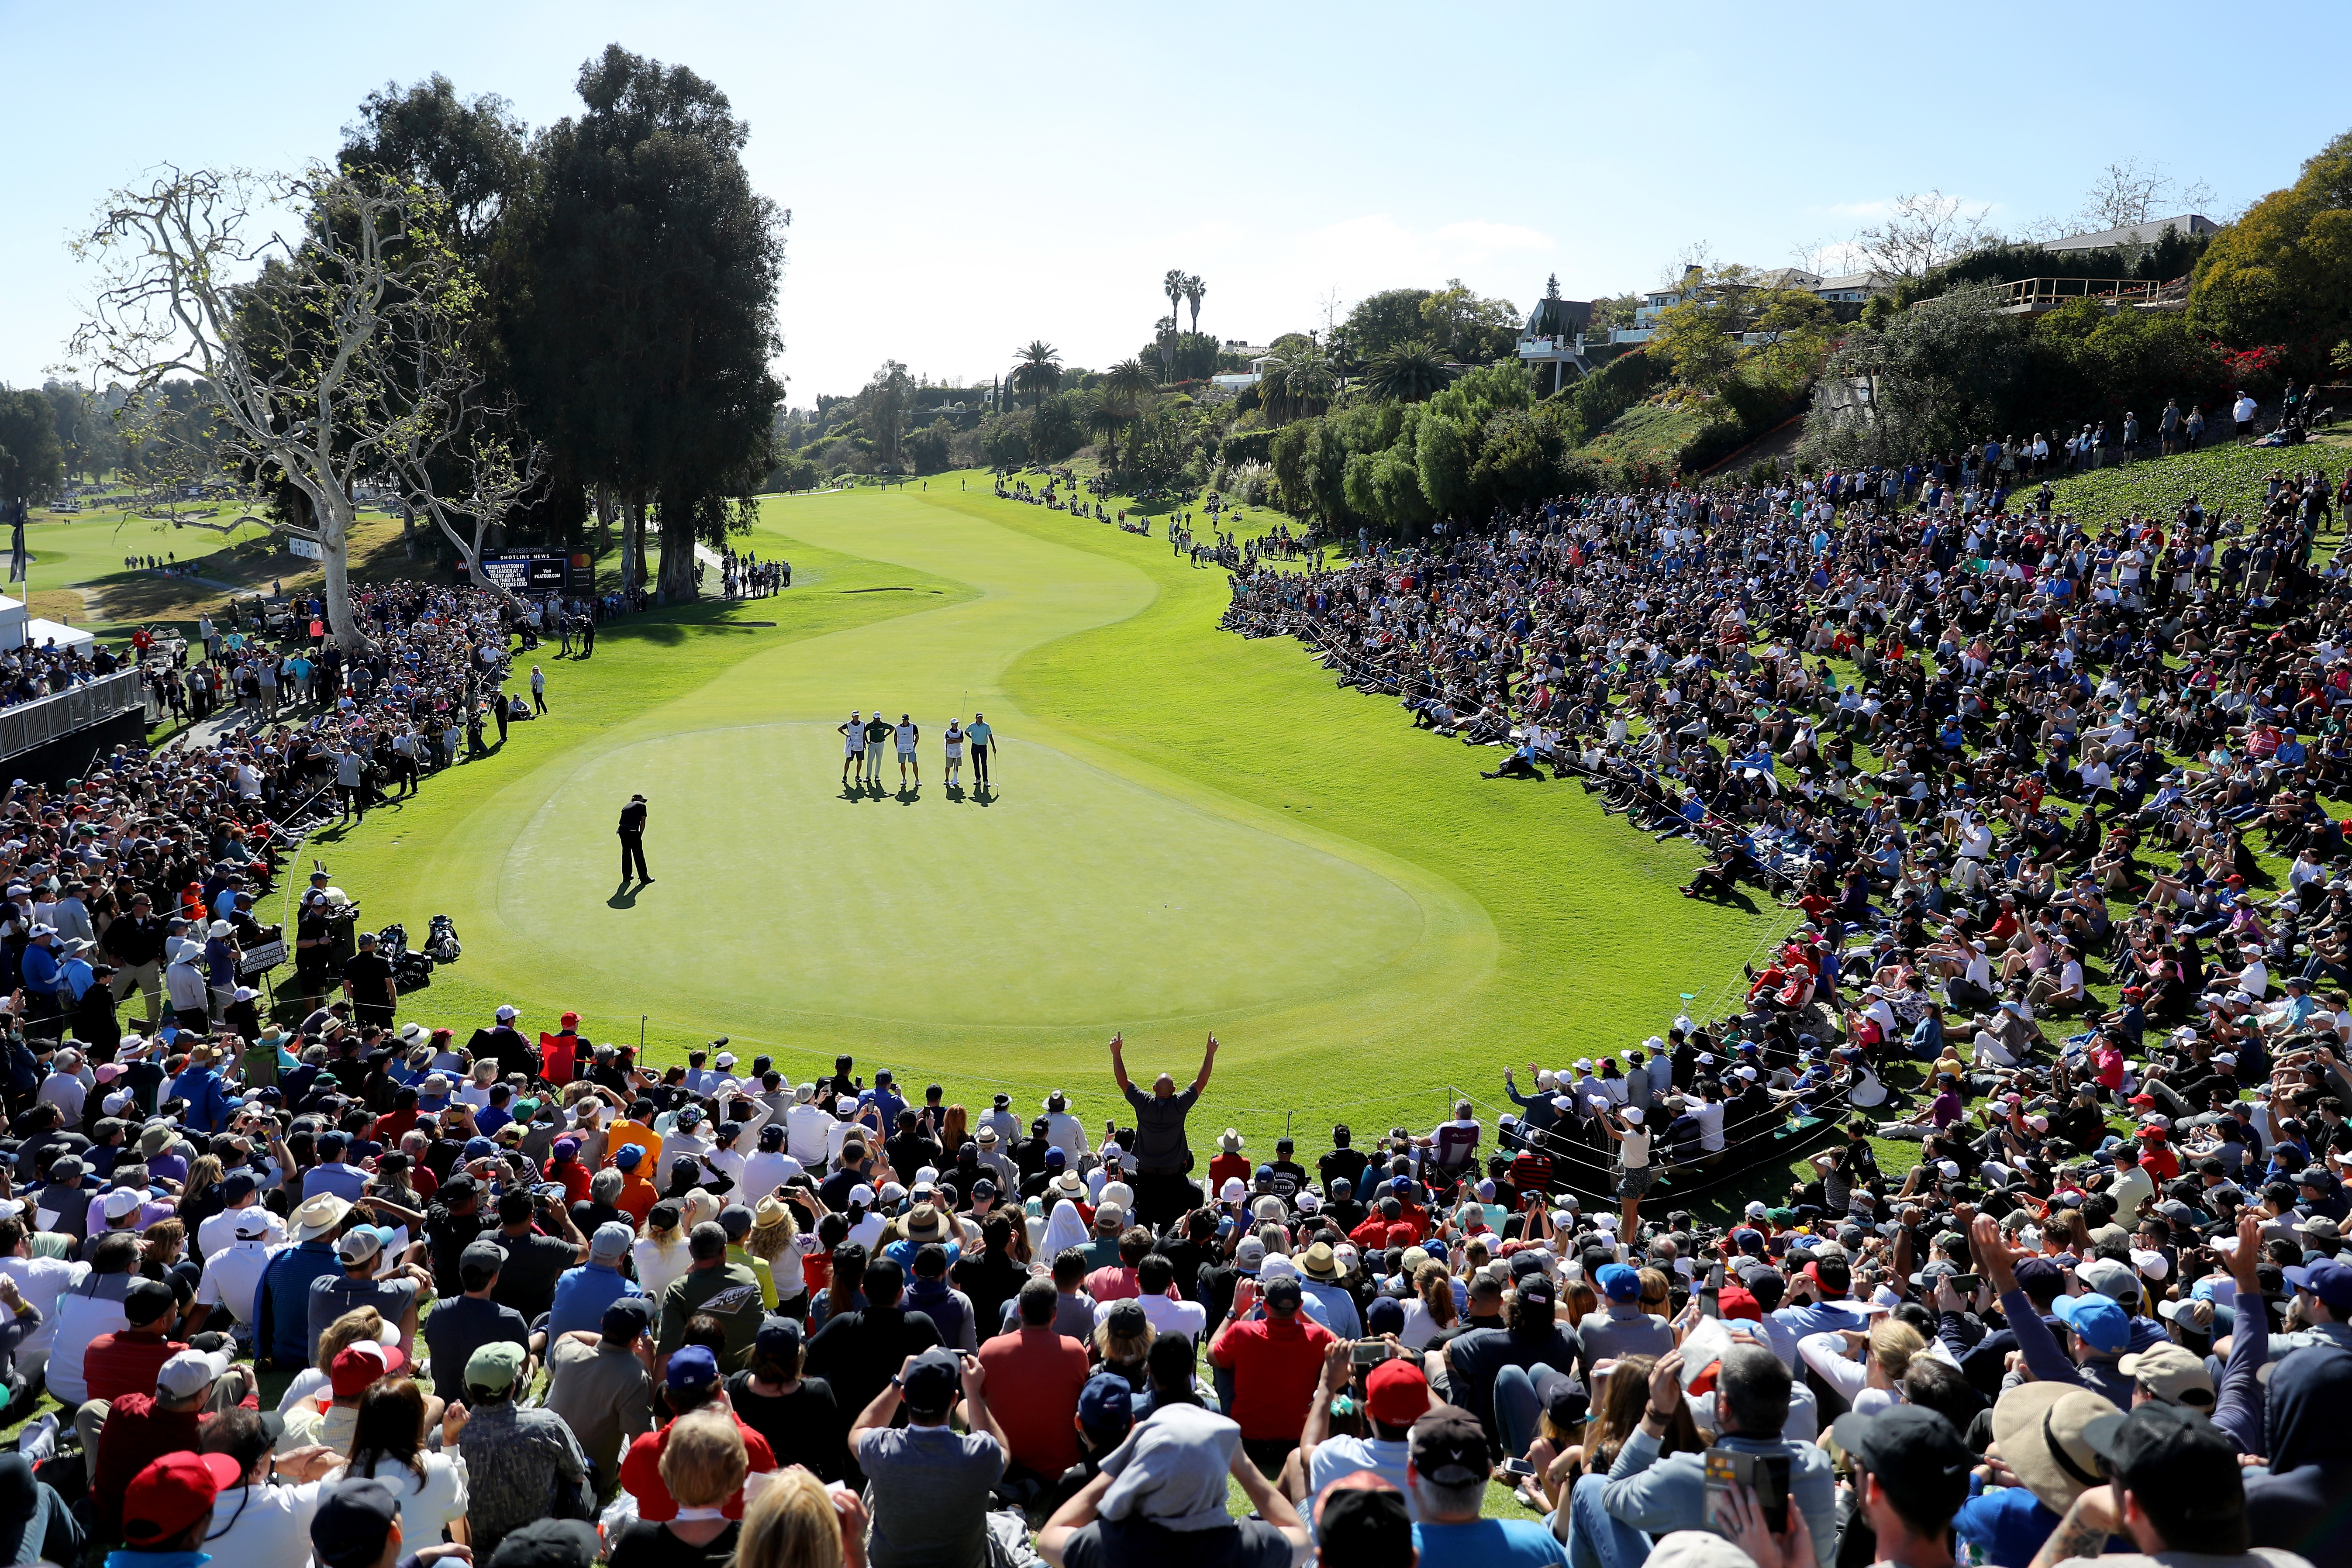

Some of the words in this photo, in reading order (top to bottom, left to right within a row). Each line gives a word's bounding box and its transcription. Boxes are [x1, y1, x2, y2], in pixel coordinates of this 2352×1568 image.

[241, 949, 279, 966] MICKELSON
[246, 947, 261, 957] HIRI
[243, 957, 278, 973] SAUNDERS
[393, 969, 423, 983] Callaway
[1275, 1172, 1298, 1180] ANNIVERSARY
